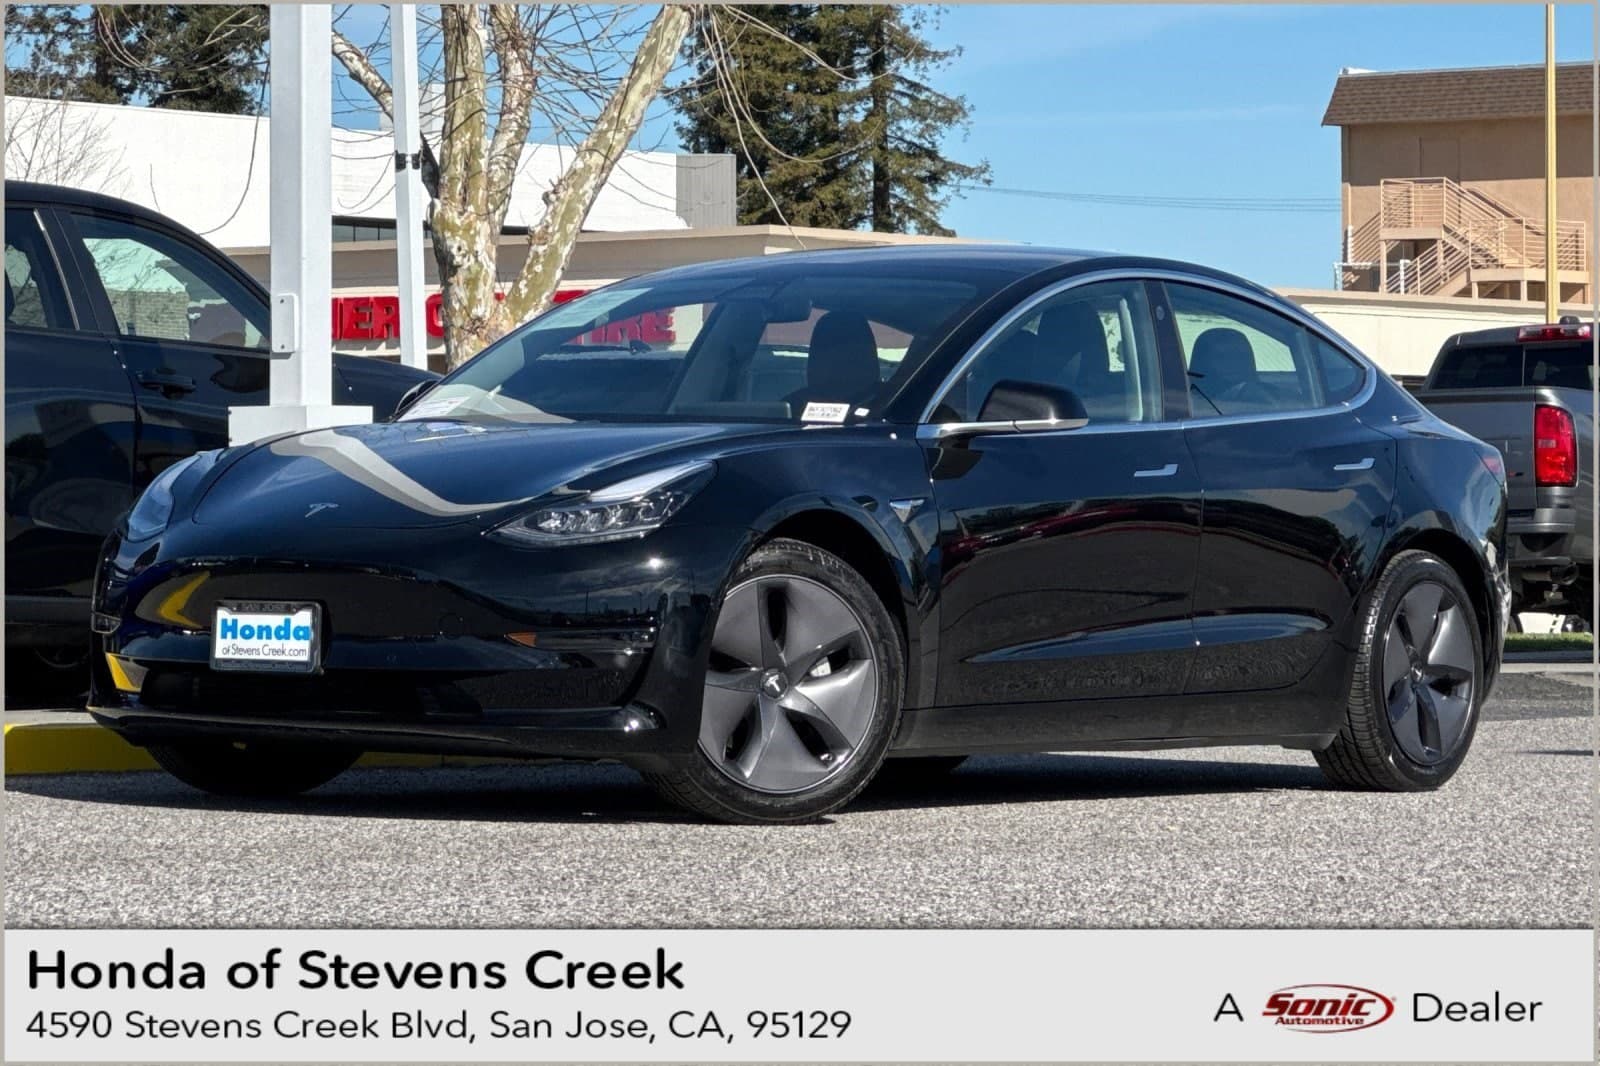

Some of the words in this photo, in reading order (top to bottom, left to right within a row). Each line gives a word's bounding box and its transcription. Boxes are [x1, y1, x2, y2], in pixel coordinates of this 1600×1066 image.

[220, 617, 311, 641] Honda
[222, 644, 231, 656] of
[231, 643, 260, 656] Stevens
[261, 643, 307, 657] Creek.com
